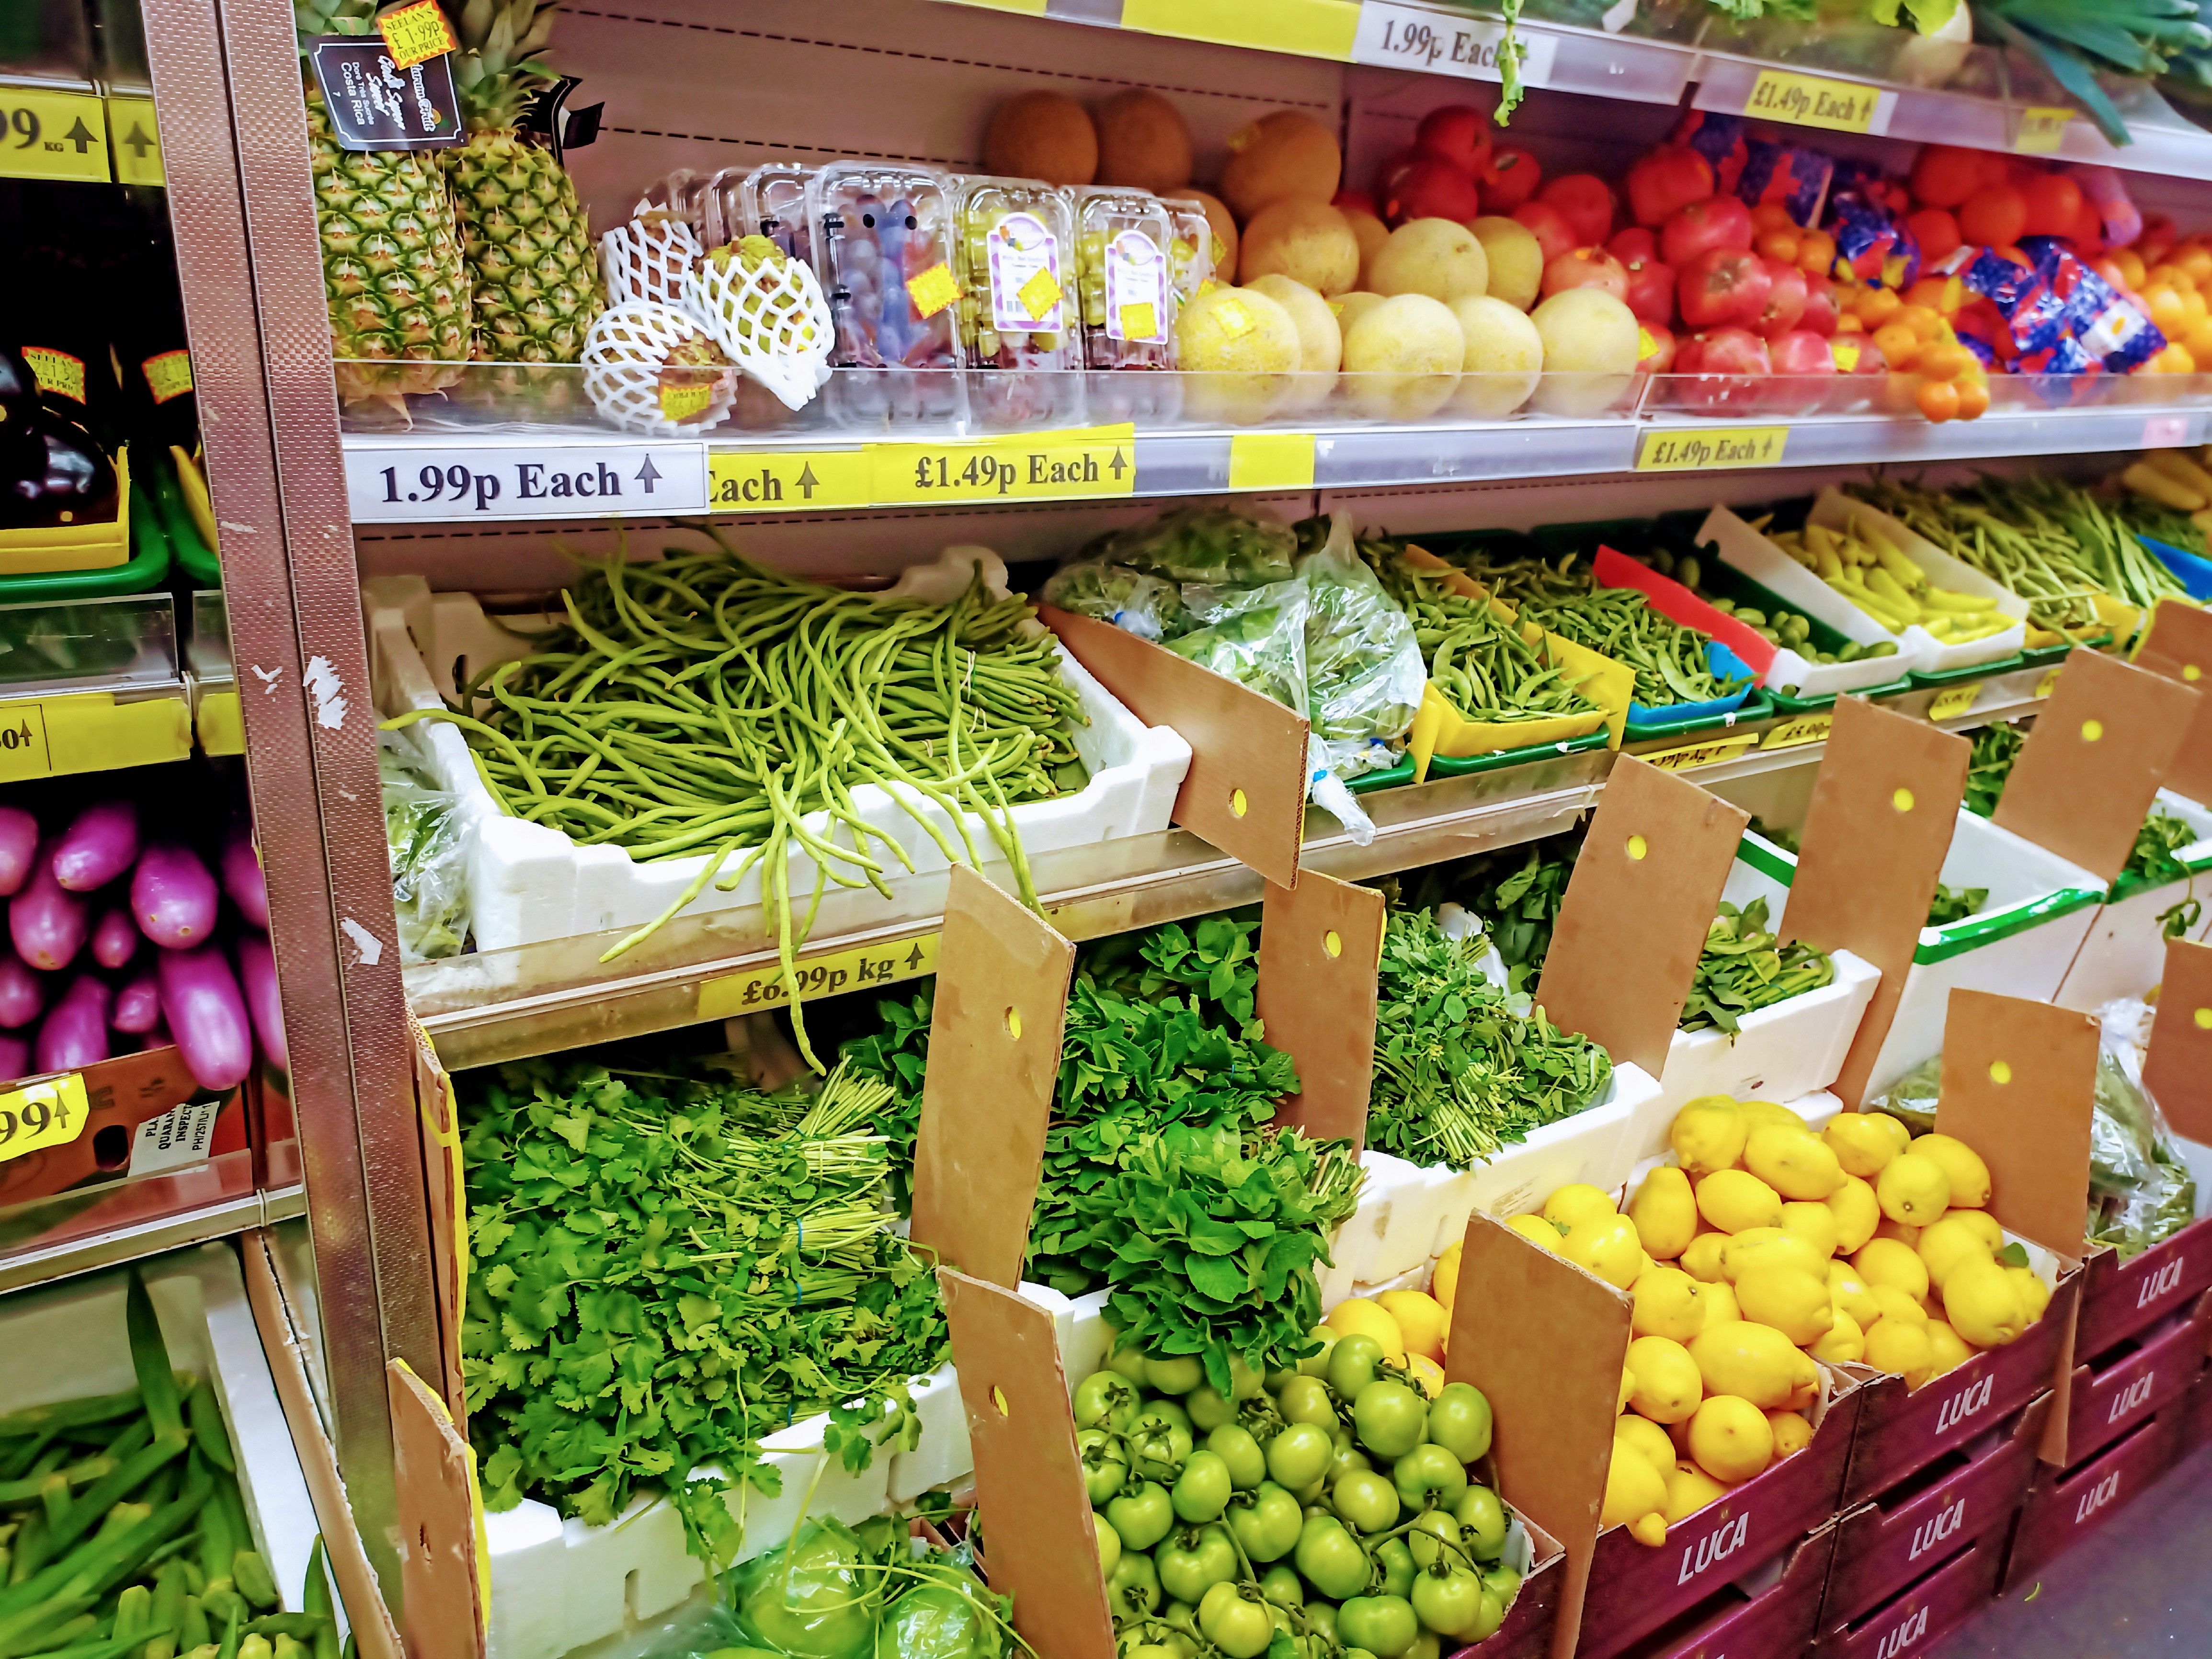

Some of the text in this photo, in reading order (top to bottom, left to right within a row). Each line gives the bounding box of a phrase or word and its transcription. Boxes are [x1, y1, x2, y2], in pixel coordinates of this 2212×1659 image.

[399, 37, 445, 59] OUR PRICE
[1381, 20, 1443, 66] 1.99p
[341, 62, 365, 125] Costa Rica
[1753, 81, 1854, 121] £1.49p Each
[44, 141, 64, 152] KG
[915, 453, 1099, 493] £1.49p Each
[1653, 438, 1756, 467] £1.49p Each
[380, 462, 622, 510] 1.99p Each
[857, 958, 896, 983] kg
[2137, 1256, 2183, 1308] LUCA
[1936, 1374, 1994, 1434] LUCA
[2108, 1371, 2154, 1424] LUCA
[2075, 1470, 2119, 1523] LUCA
[1677, 1511, 1749, 1586] LUCA
[1909, 1498, 1965, 1561] LUCA
[1877, 1606, 1928, 1659] LUCA
